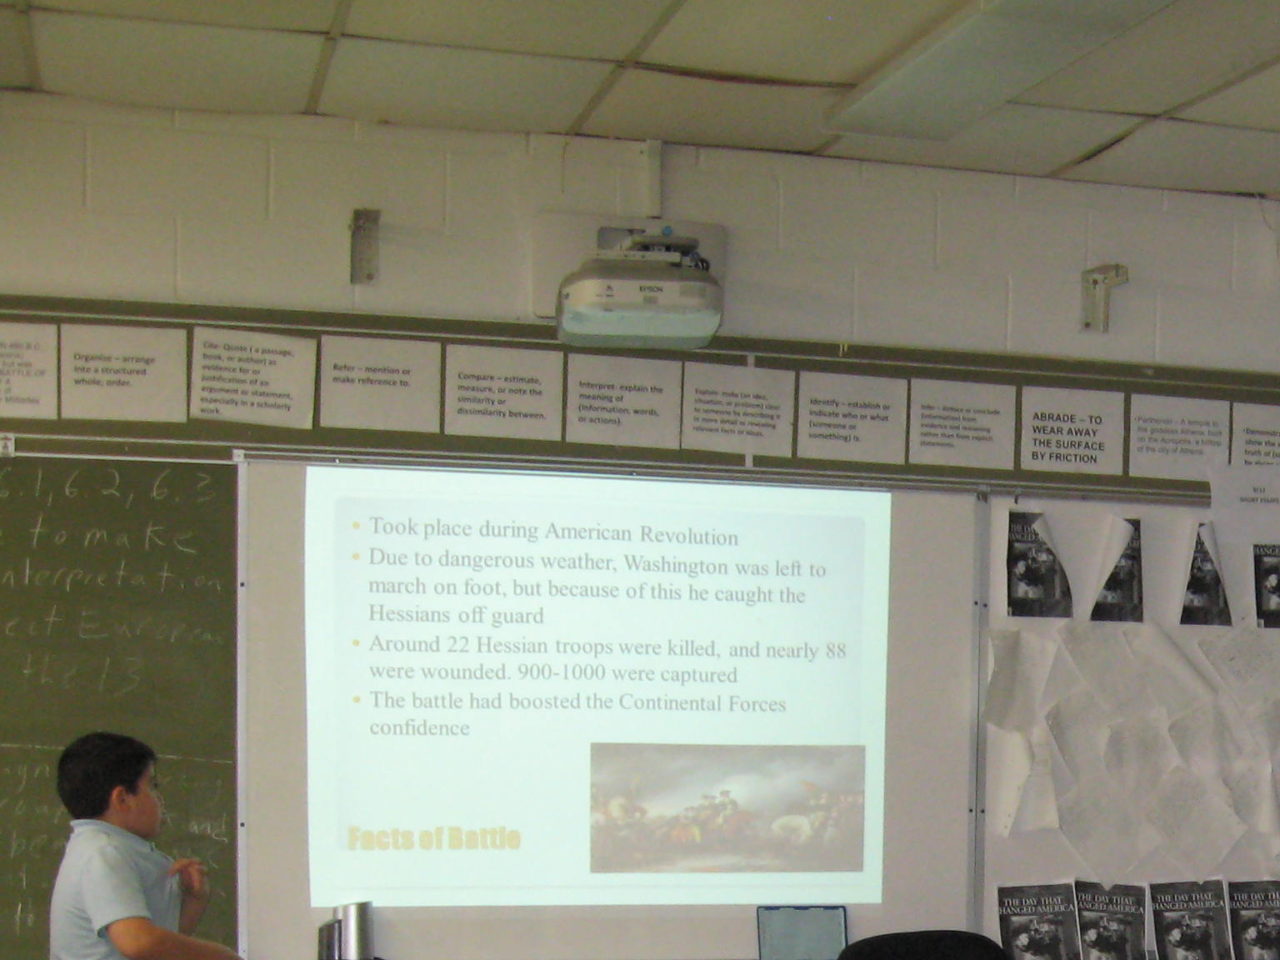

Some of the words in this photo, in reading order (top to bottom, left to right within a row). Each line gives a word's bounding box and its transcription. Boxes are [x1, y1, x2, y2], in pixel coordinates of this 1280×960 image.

[333, 363, 355, 371] Refer
[364, 367, 400, 375] mention
[358, 377, 397, 386] reference
[457, 373, 495, 382] Compare
[504, 375, 542, 385] estimate,
[619, 385, 648, 393] explain
[457, 396, 495, 405] similarity
[579, 393, 613, 402] meaning
[1033, 412, 1076, 423] ABRADE
[1088, 416, 1103, 425] TO
[1032, 425, 1064, 435] WEAR
[1067, 427, 1098, 437] AWAY
[1033, 438, 1052, 448] THE
[1055, 440, 1105, 451] SURFACE
[1032, 451, 1046, 460] BY
[1049, 452, 1097, 463] FRICTION
[369, 517, 418, 535] Took
[424, 519, 473, 540] place
[479, 521, 538, 543] during
[545, 522, 632, 542] American
[640, 526, 739, 546] Revolution
[369, 547, 408, 566] Due
[414, 551, 433, 566] to
[438, 550, 535, 572] dangerous
[541, 552, 617, 572] weather,
[624, 554, 728, 578] Washington
[736, 562, 769, 577] was
[775, 560, 802, 577] left
[809, 564, 826, 578] to
[368, 577, 426, 595] march
[433, 582, 458, 596] on
[464, 578, 507, 598] foot,
[513, 580, 542, 597] but
[548, 580, 620, 598] because
[626, 582, 649, 599] of
[650, 583, 682, 600] this
[688, 584, 709, 601] he
[714, 586, 773, 607] caught
[779, 587, 806, 604] the
[369, 604, 450, 623] Hessians
[458, 606, 487, 624] off
[492, 607, 544, 628] guard
[369, 635, 440, 653] Around
[447, 636, 470, 653] 22
[477, 636, 548, 654] Hessian
[555, 640, 613, 660] troops
[618, 642, 662, 656] were
[667, 639, 721, 659] killed,
[729, 641, 760, 658] and
[766, 642, 819, 664] nearly
[826, 642, 847, 659] 88
[370, 666, 415, 680] were
[421, 663, 512, 681] wounded.
[517, 663, 606, 681] 900-1000
[612, 668, 655, 682] were
[661, 667, 738, 687] captured
[370, 691, 406, 709] The
[412, 692, 463, 709] battle
[469, 693, 502, 709] had
[509, 693, 581, 710] boosted
[586, 693, 613, 710] the
[619, 694, 722, 712] Continental
[729, 695, 787, 713] Forces
[369, 719, 470, 736] confidence
[348, 826, 415, 851] Facts
[419, 826, 444, 850] of
[448, 826, 521, 850] Battle
[1004, 897, 1019, 906] THE
[1022, 897, 1037, 906] DAY
[1041, 896, 1062, 906] THAT
[1078, 893, 1092, 901] THE
[1095, 893, 1110, 903] DAY
[1113, 895, 1134, 905] THAT
[1157, 894, 1172, 903] THE
[1174, 893, 1189, 902] DAY
[1192, 892, 1213, 901] THAT
[1233, 893, 1248, 901] THE
[1250, 892, 1265, 901] DAY
[999, 905, 1036, 914] HANGED
[1038, 904, 1075, 913] AMERICA
[1108, 904, 1144, 914] AMERICA
[1188, 900, 1224, 909] AMERICA
